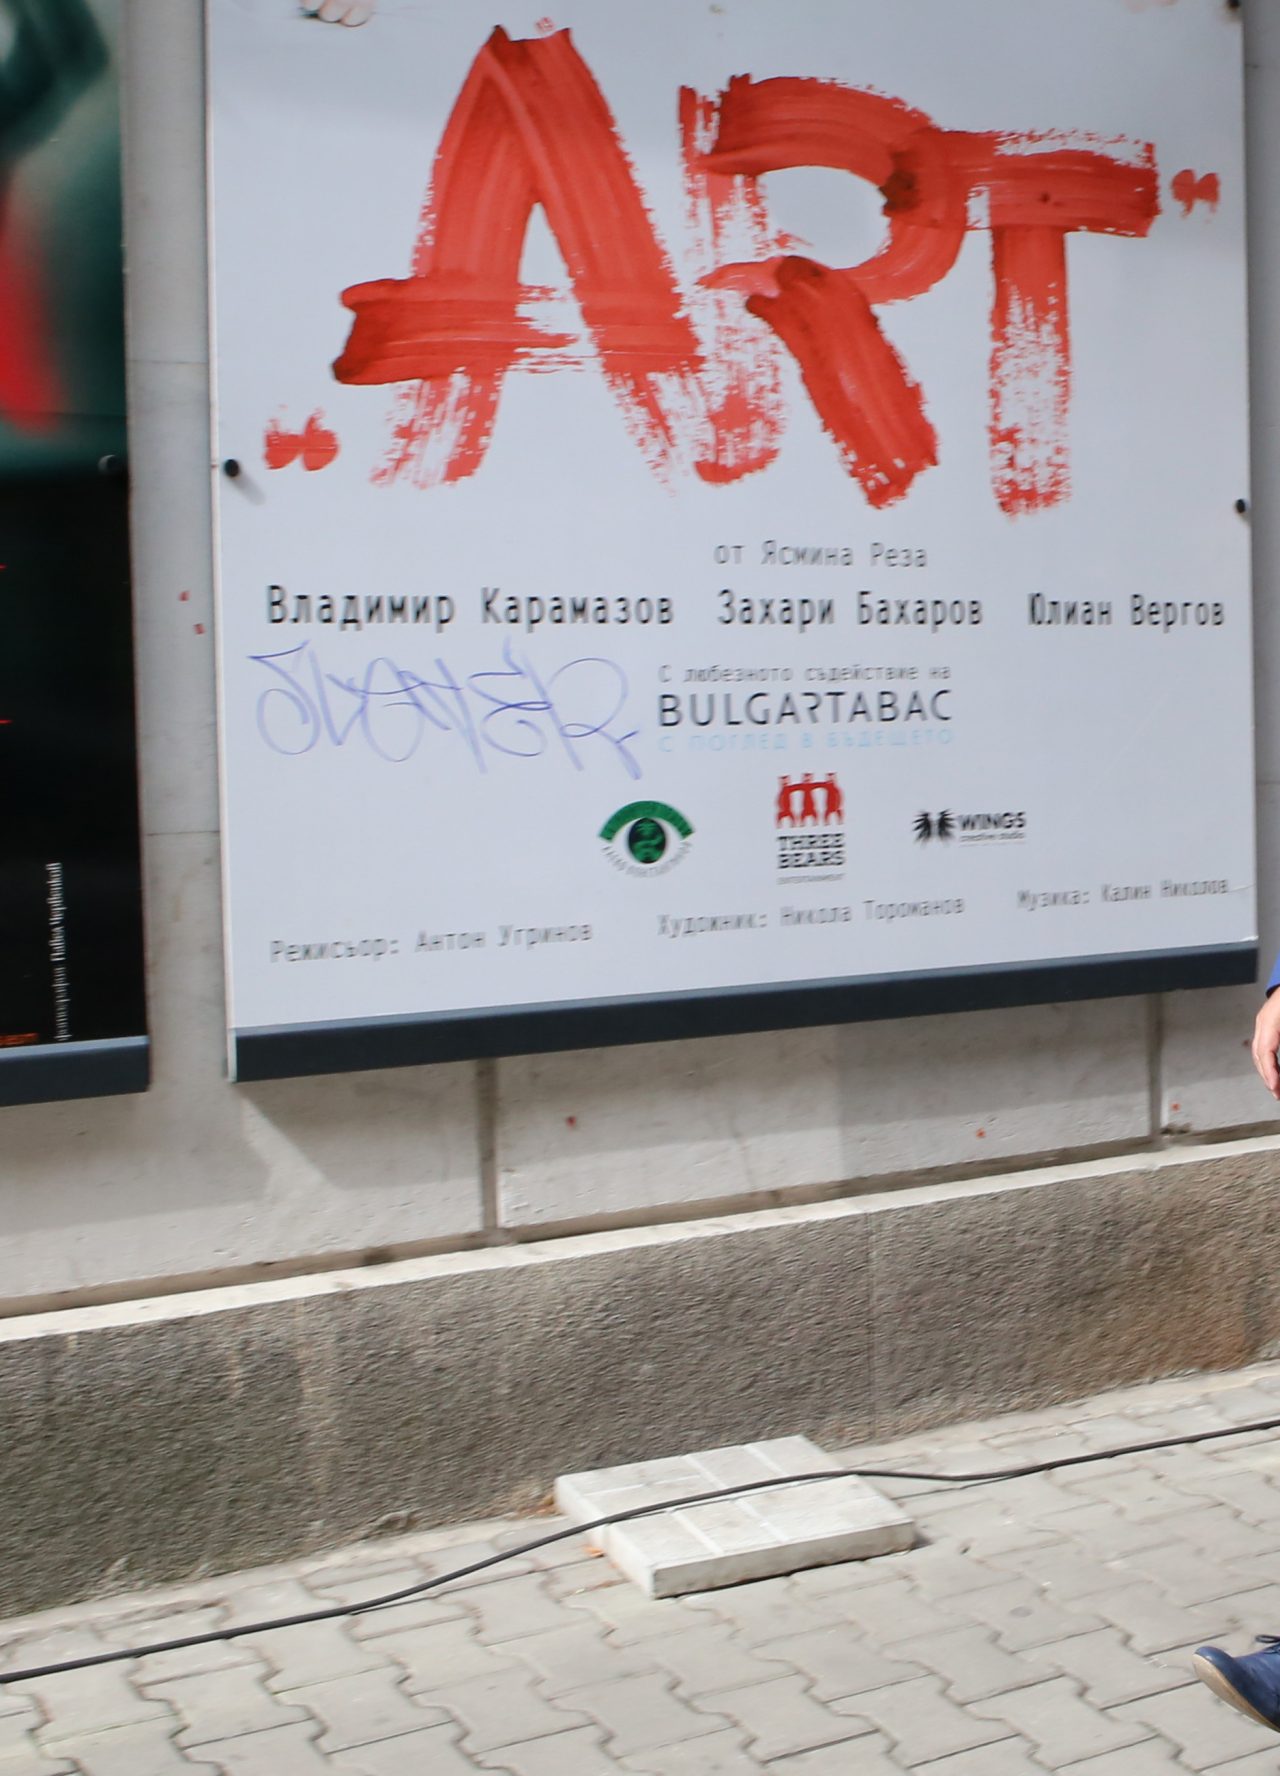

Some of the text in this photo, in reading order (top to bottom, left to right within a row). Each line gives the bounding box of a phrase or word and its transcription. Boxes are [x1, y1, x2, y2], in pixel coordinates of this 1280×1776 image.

[713, 540, 928, 568] от Ясмина Реза
[266, 585, 674, 634] Владимир Карамазов
[717, 589, 984, 635] Захари Бахаров
[1027, 591, 1226, 634] Юлиан Вергов
[683, 665, 794, 683] любезното
[804, 664, 919, 683] съдействие
[928, 664, 951, 680] на
[657, 689, 952, 728] BULGARTABAC
[958, 811, 1027, 831] WINGS
[777, 833, 846, 851] THREE
[777, 850, 847, 869] BEARS
[414, 930, 486, 952] Антон
[496, 923, 593, 951] Угринов
